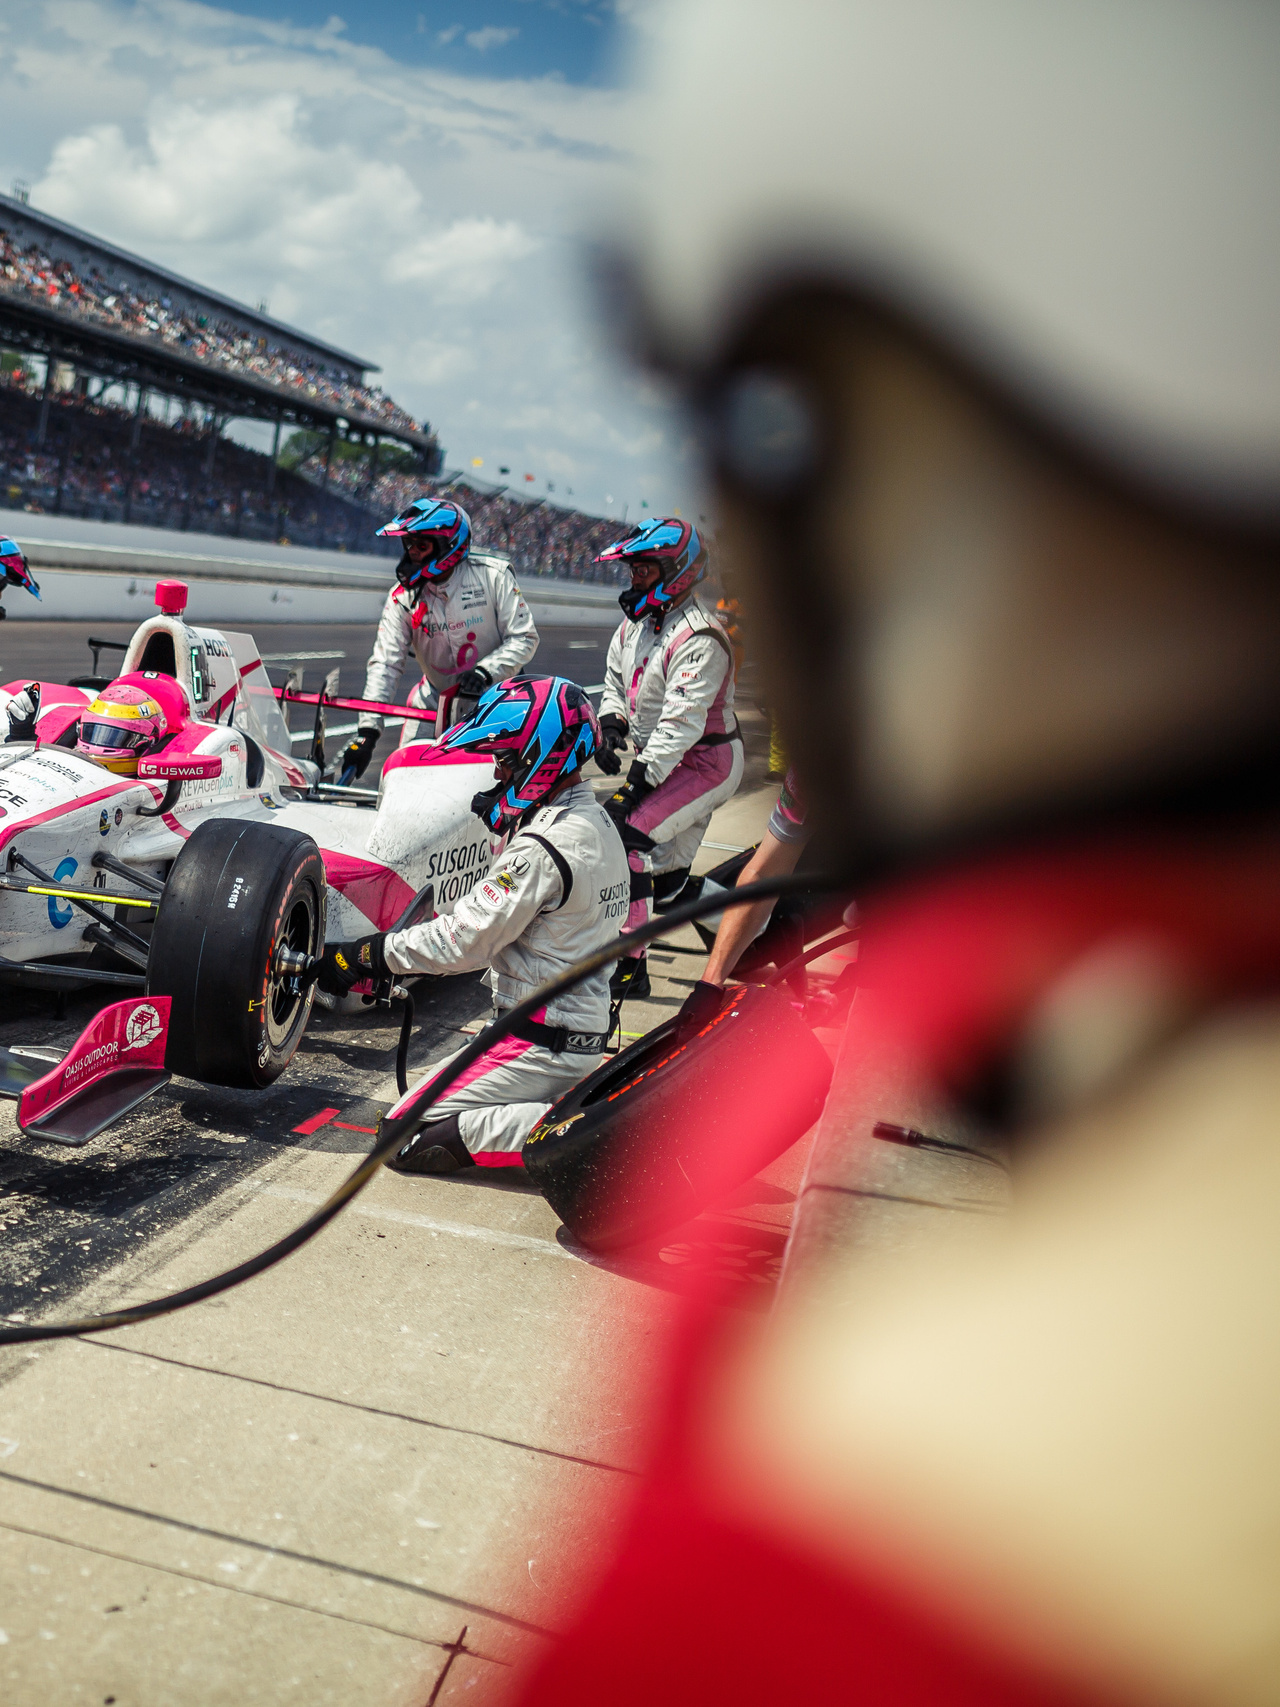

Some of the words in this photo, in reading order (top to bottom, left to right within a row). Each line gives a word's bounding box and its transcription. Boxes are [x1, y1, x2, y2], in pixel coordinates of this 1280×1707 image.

[160, 766, 204, 776] USWAG
[517, 747, 570, 800] BELL
[483, 884, 500, 904] BELL
[64, 1075, 80, 1088] LIVING
[85, 1055, 118, 1075] LANDSCAPES
[65, 1059, 84, 1079] OASIS
[84, 1041, 119, 1067] OUTDOOR
